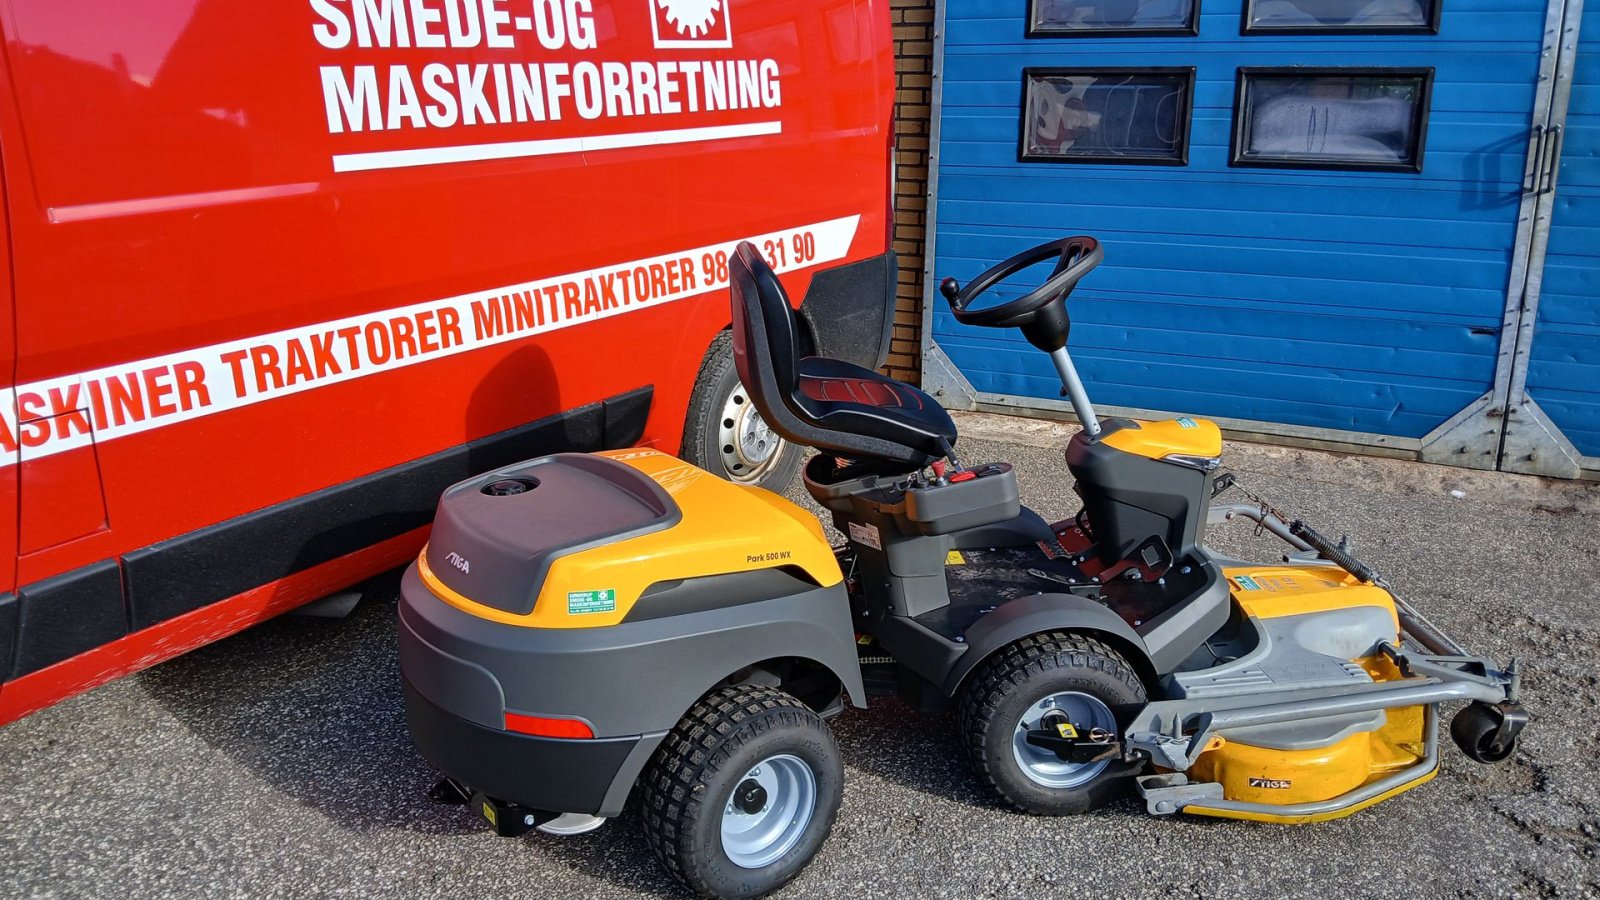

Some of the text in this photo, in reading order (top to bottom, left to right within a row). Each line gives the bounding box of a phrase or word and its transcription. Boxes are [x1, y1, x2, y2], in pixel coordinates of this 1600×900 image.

[310, 0, 598, 49] SMEDE-OG
[319, 59, 782, 134] MASKINFORRETNING
[220, 307, 464, 398] TRAKTORER
[471, 258, 696, 341] MINITRAKTORER
[702, 250, 729, 286] 98
[764, 238, 787, 270] 31
[793, 231, 815, 264] 90
[445, 551, 469, 575] STIGA
[747, 551, 791, 563] Park 500 WX
[1251, 779, 1290, 788] STIGA
